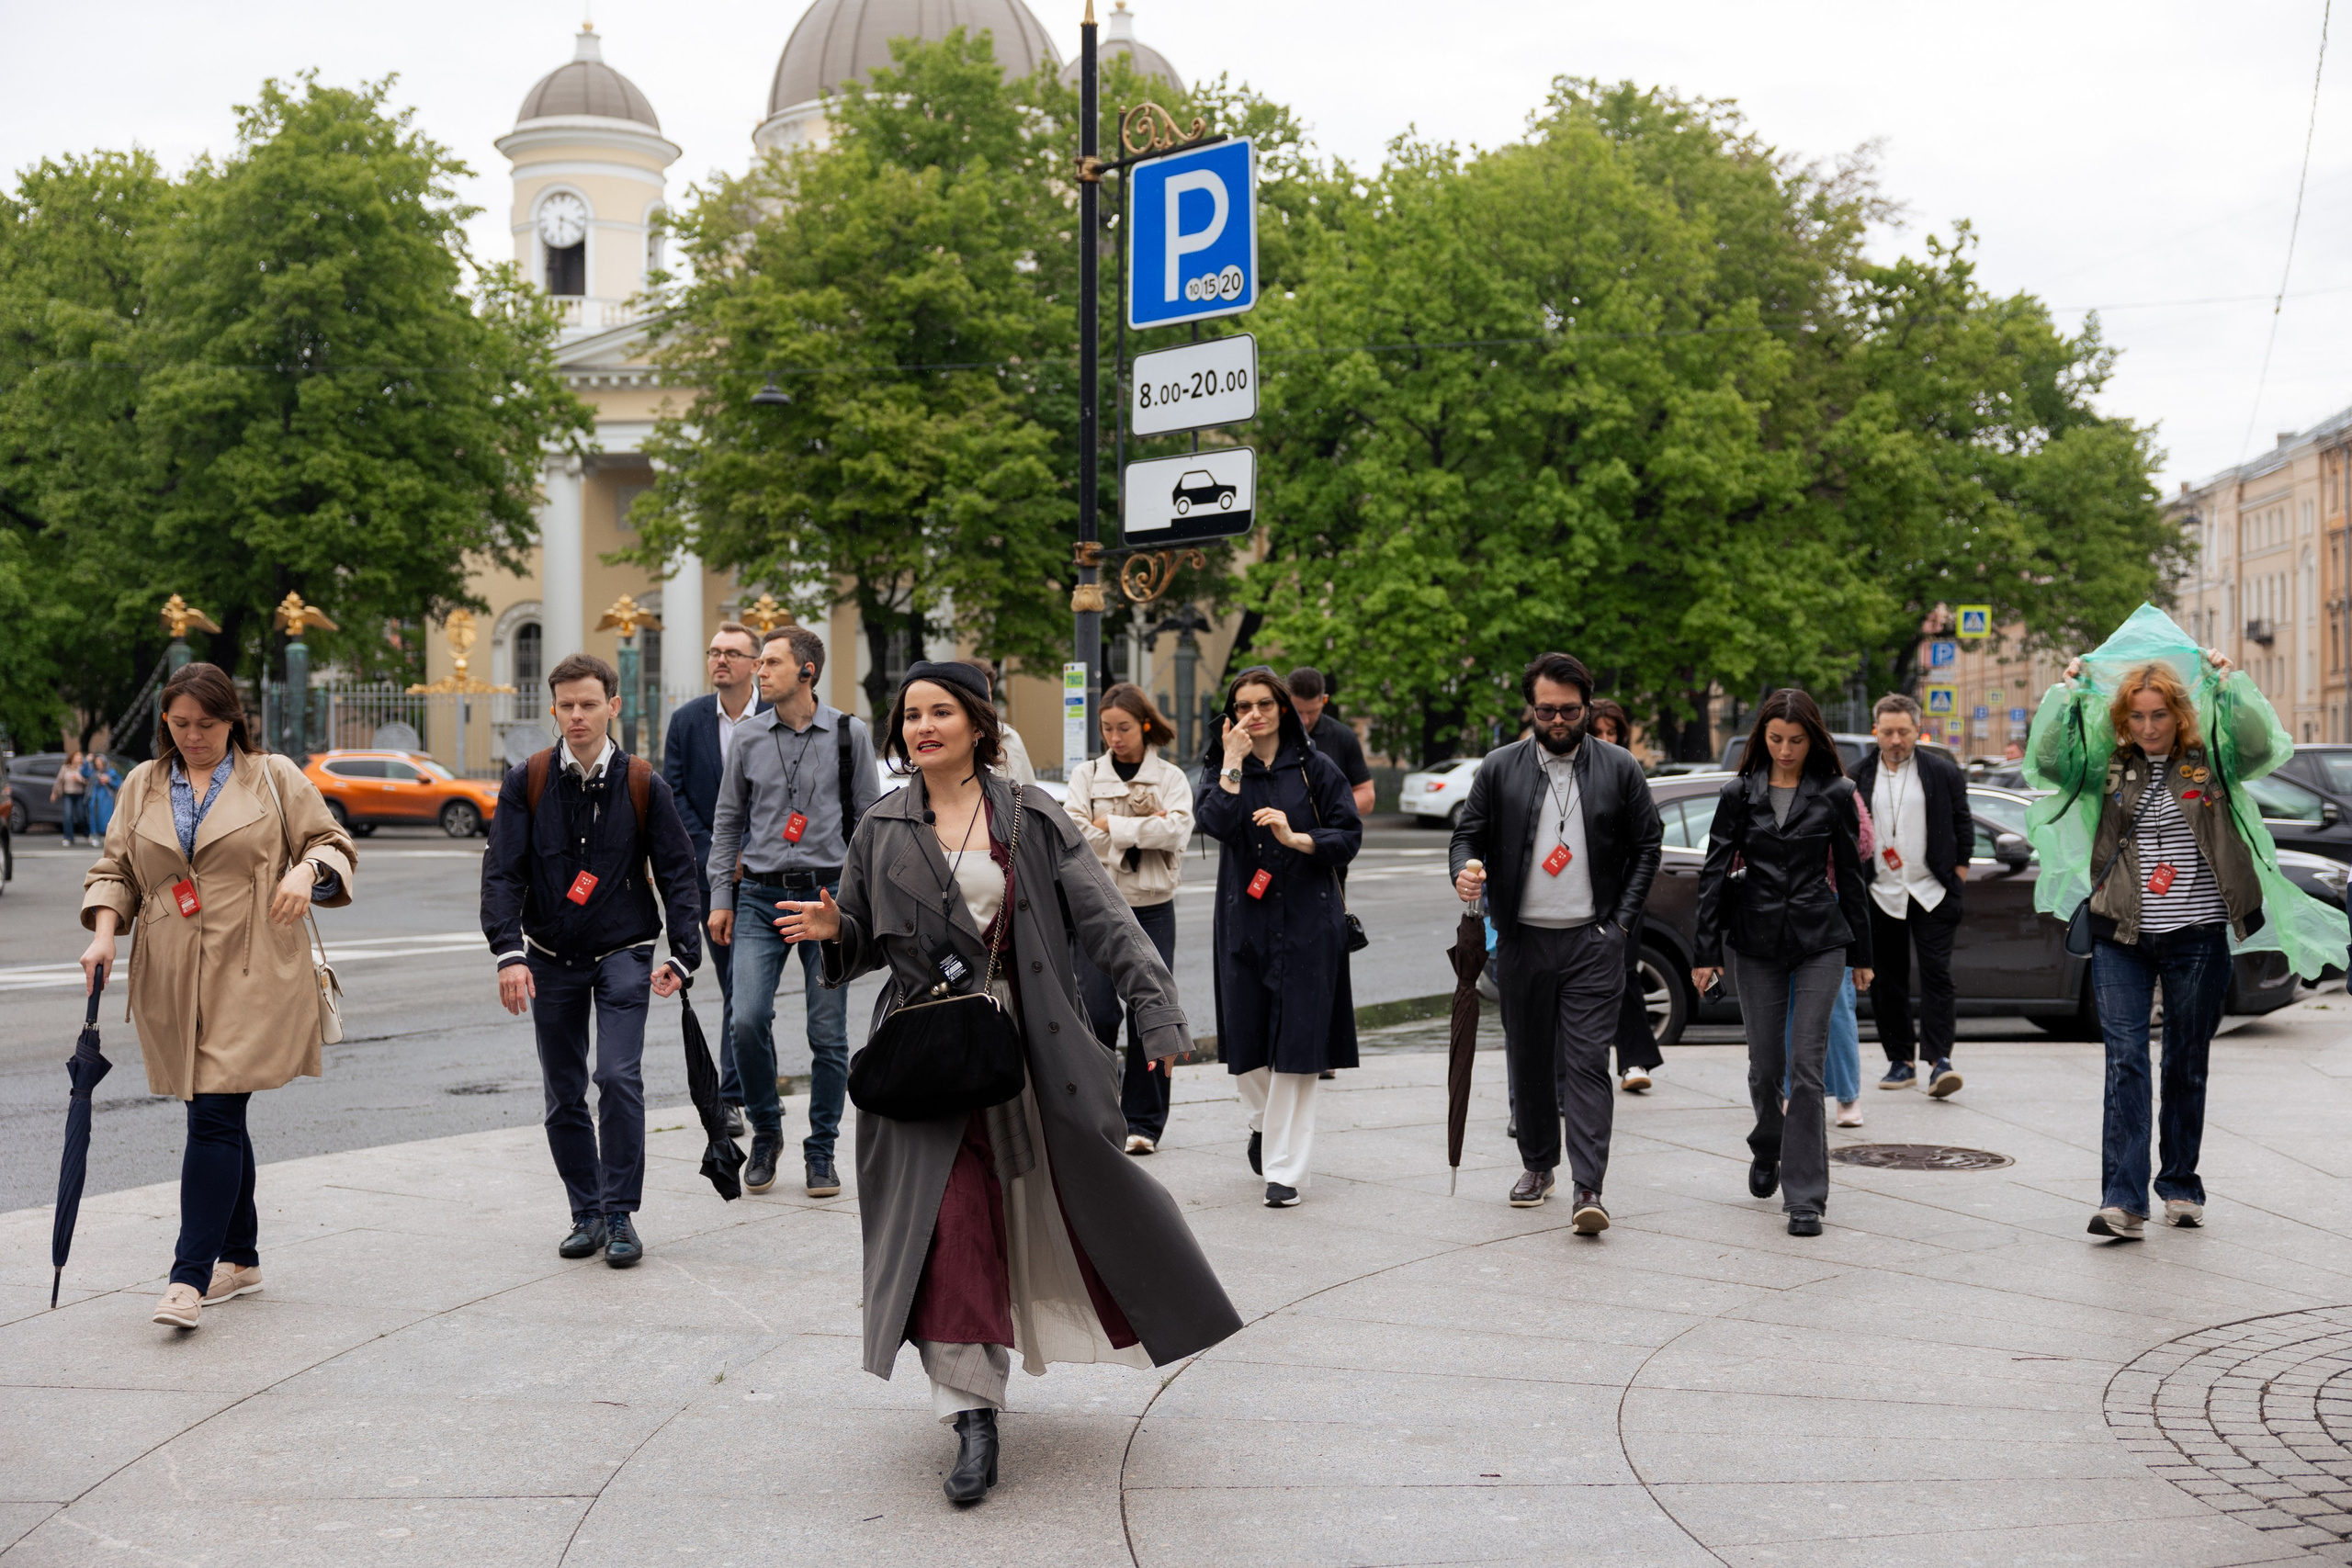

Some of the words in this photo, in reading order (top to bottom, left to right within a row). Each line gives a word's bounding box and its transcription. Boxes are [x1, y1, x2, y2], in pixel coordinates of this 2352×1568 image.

[1164, 169, 1229, 303] P
[1189, 283, 1200, 296] 10
[1204, 278, 1216, 295] 15
[1221, 272, 1241, 294] 20
[1139, 368, 1248, 409] 8.00-20.00
[1937, 644, 1953, 665] P
